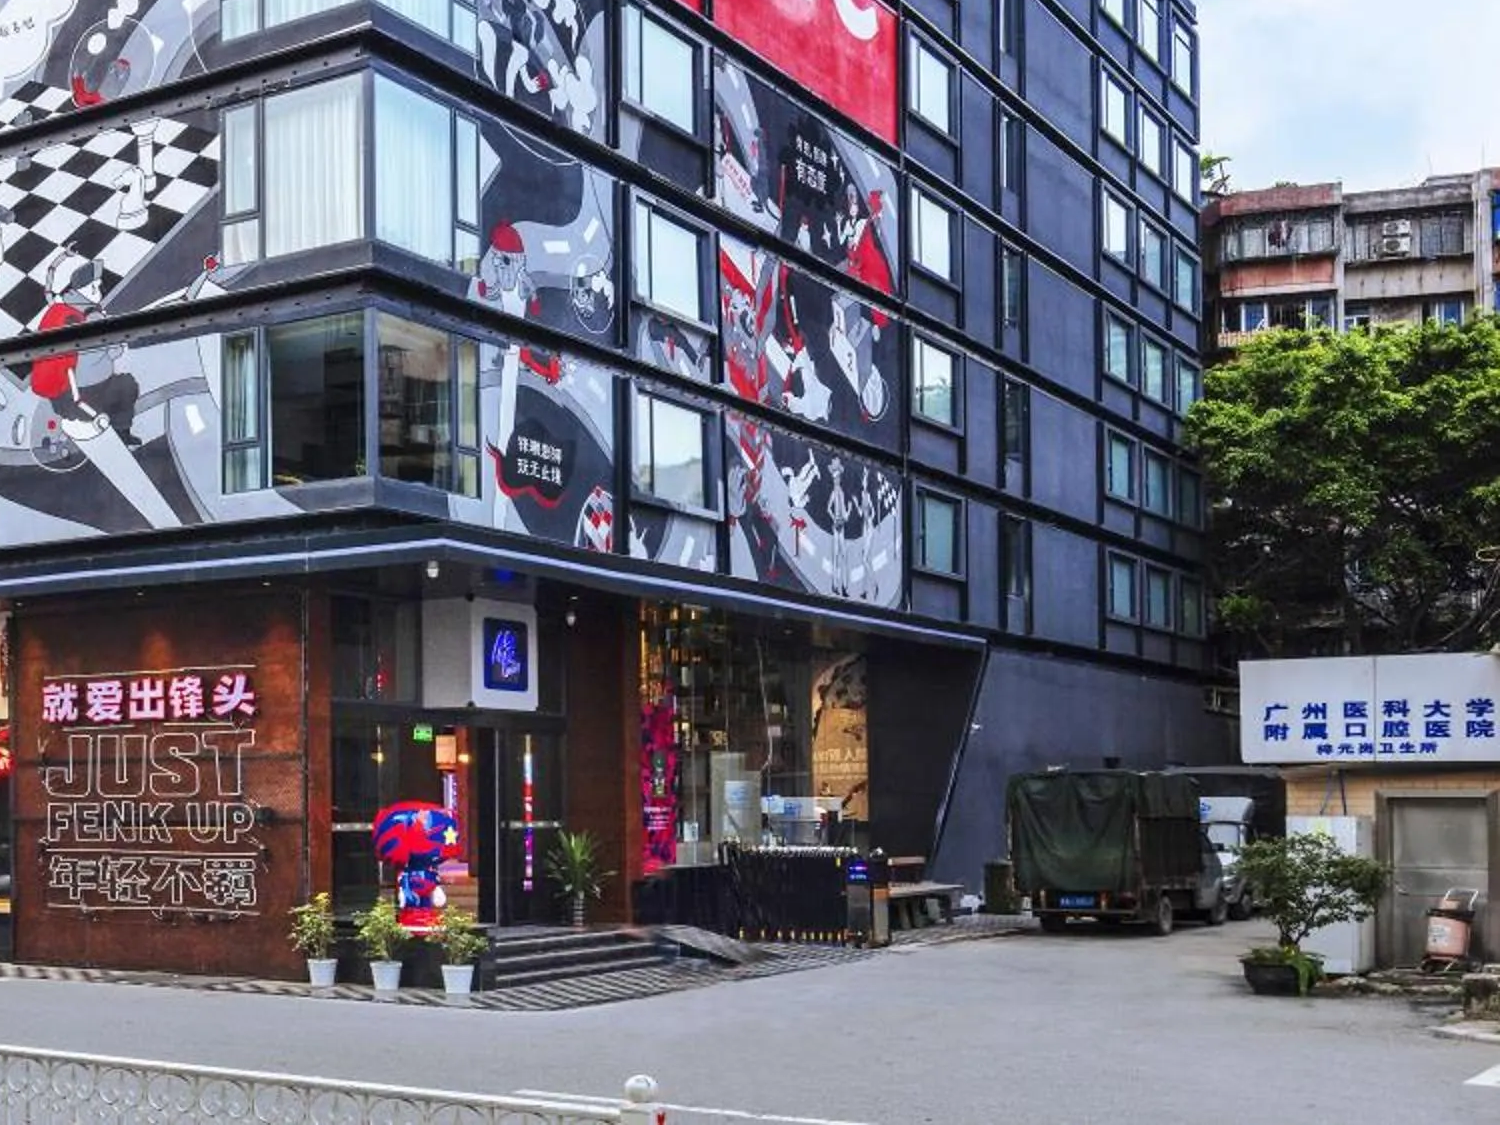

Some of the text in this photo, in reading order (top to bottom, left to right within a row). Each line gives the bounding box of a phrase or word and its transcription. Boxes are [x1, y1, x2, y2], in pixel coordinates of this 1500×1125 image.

[42, 674, 257, 722] 就爱出锋头
[1263, 698, 1496, 722] 广州医科大学
[1263, 719, 1496, 742] 附属口腔医院
[45, 729, 256, 798] JUST
[47, 801, 255, 844] FENK UP
[50, 854, 257, 906] 年轻不羁
